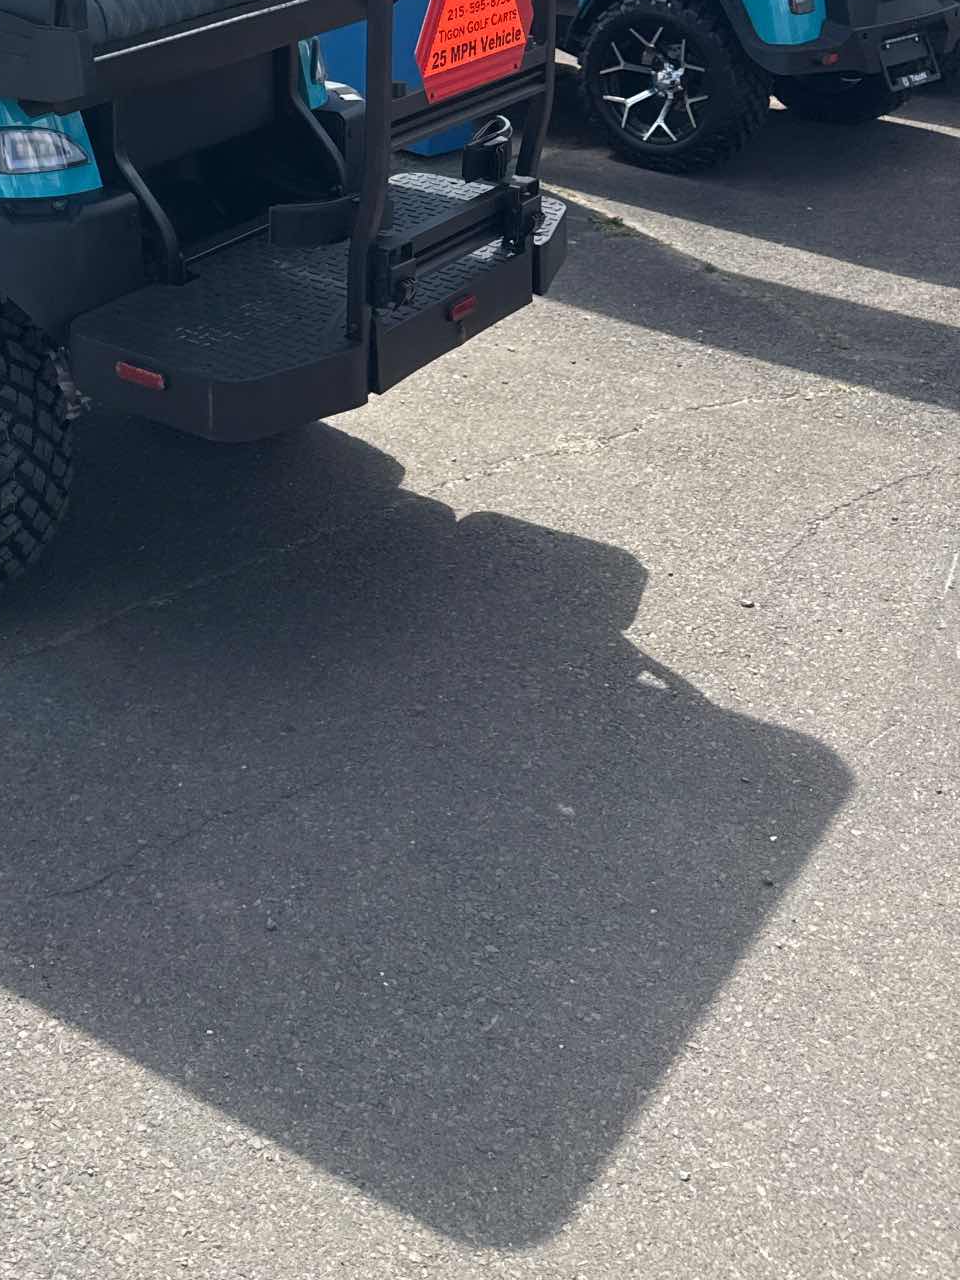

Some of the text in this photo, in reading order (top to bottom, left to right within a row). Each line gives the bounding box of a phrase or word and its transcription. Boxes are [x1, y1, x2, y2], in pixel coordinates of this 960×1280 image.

[438, 8, 517, 44] TIGON GOLF CARTS
[432, 26, 522, 70] 25 MPH Vehicle
